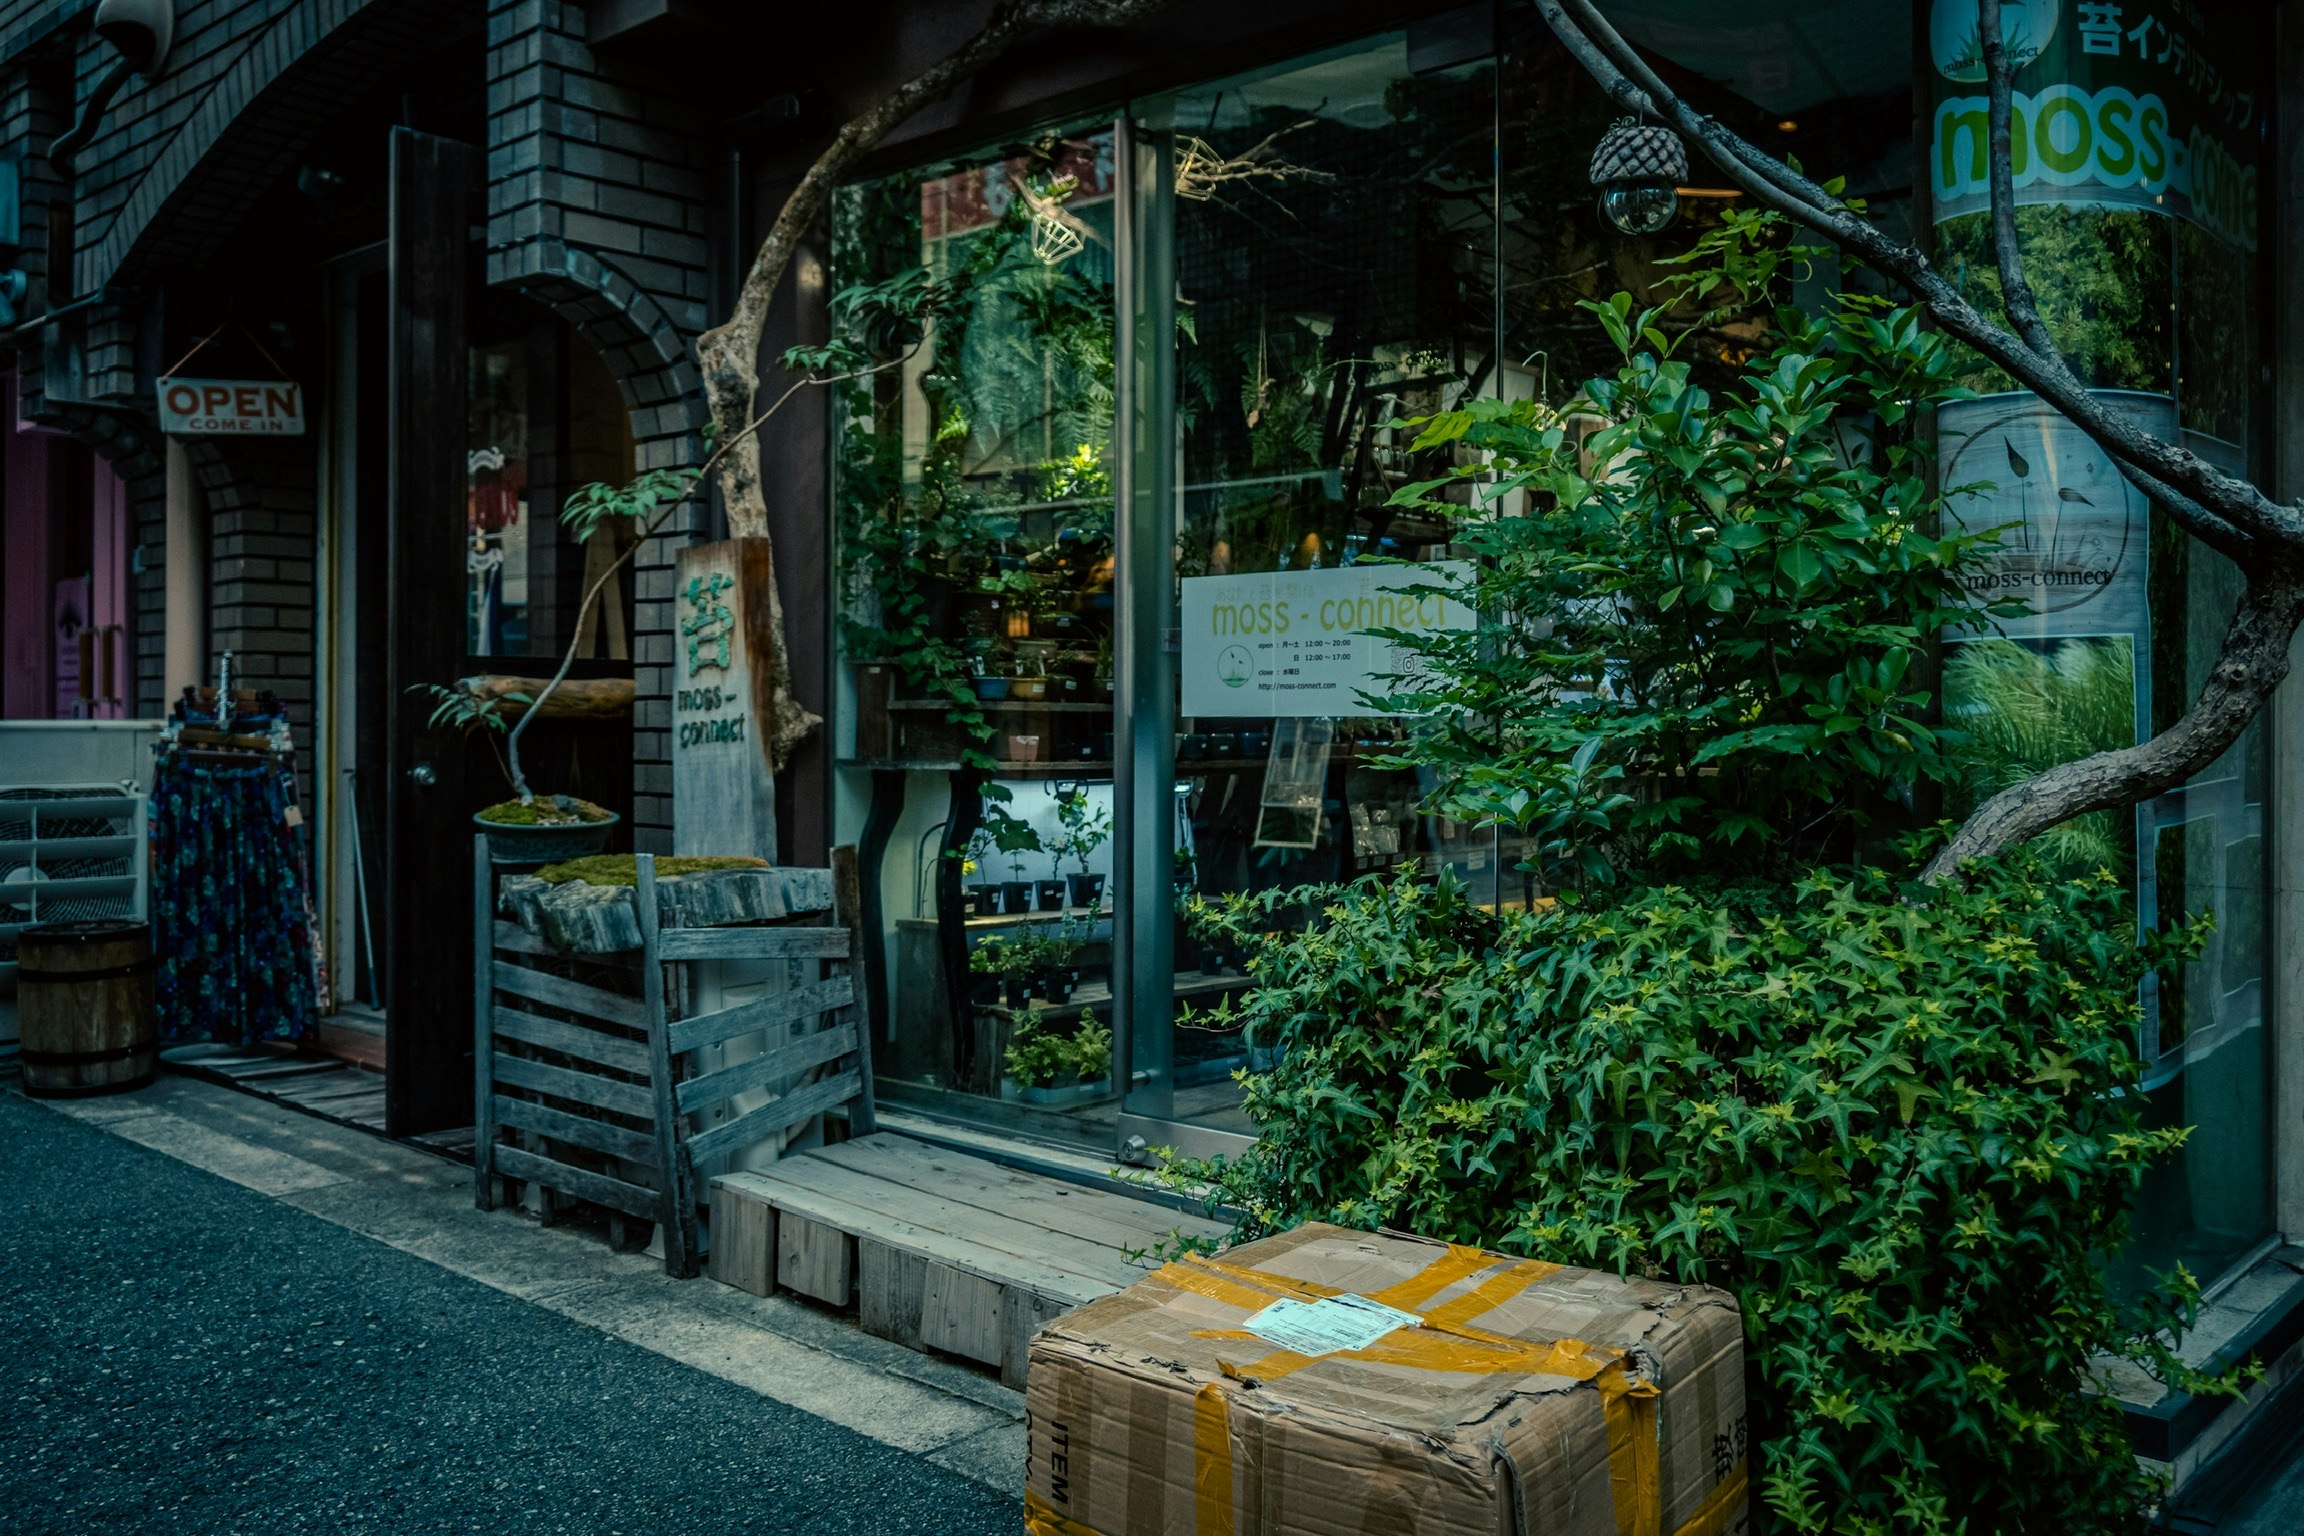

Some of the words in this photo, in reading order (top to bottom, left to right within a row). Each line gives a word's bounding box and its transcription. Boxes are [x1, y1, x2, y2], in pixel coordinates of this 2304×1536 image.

[1941, 96, 2166, 189] moss
[167, 386, 296, 417] OPEN
[190, 418, 252, 431] COME
[260, 418, 283, 431] IN
[1966, 568, 2111, 591] moss-connect
[681, 571, 735, 679] 苔
[1212, 600, 1290, 636] moss
[1319, 594, 1446, 633] connect
[1293, 654, 1300, 662] 日
[1258, 682, 1337, 691] http://moss-connect.com
[680, 713, 746, 749] connect
[1051, 1420, 1069, 1504] ITEM
